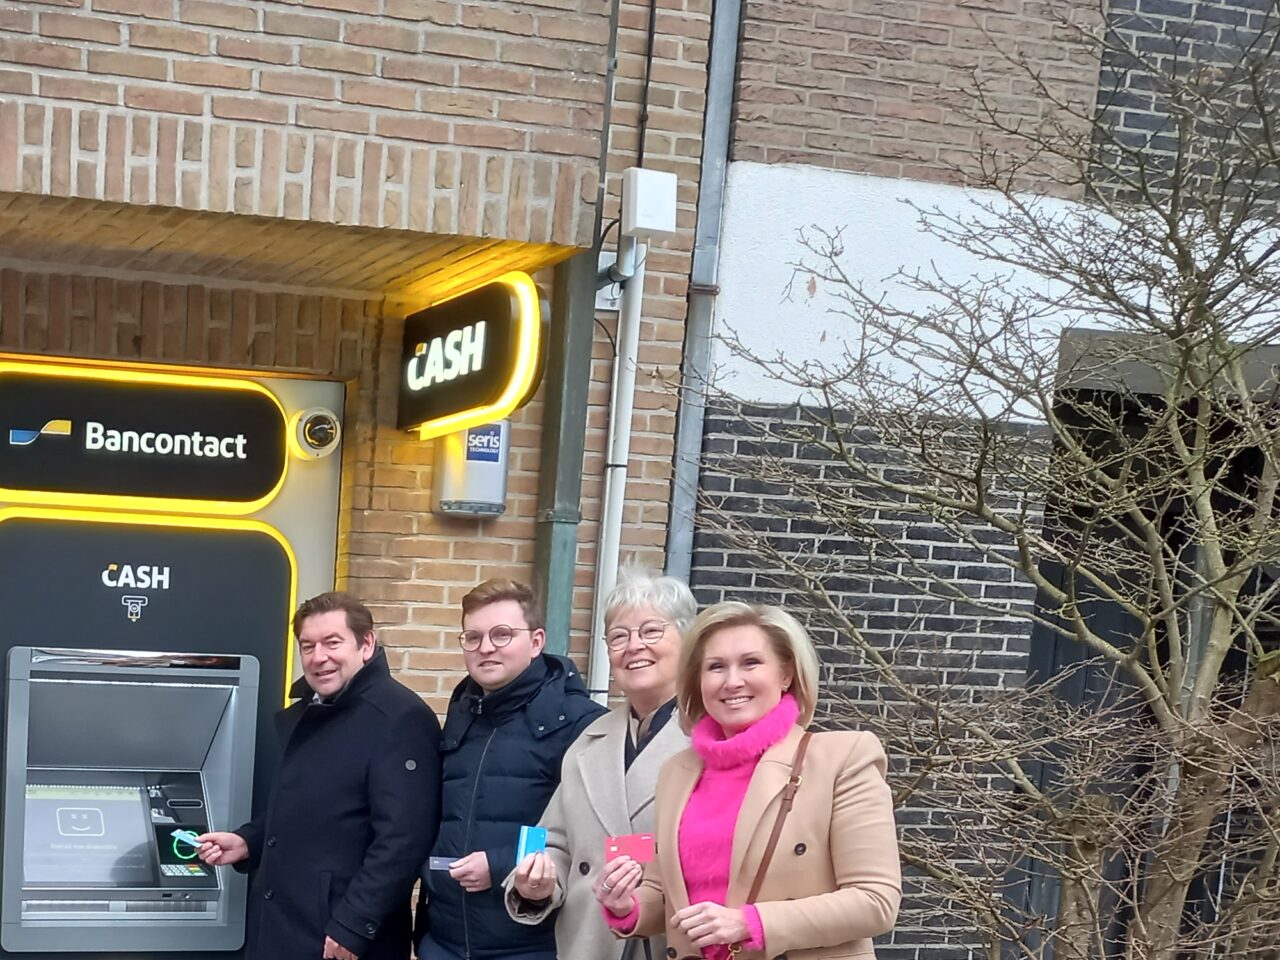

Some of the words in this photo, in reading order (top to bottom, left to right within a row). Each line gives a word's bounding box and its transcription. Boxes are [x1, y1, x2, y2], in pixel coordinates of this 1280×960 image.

[406, 321, 487, 391] CASH
[84, 421, 248, 460] Bancontact
[468, 430, 500, 448] seris
[101, 563, 170, 590] CASH
